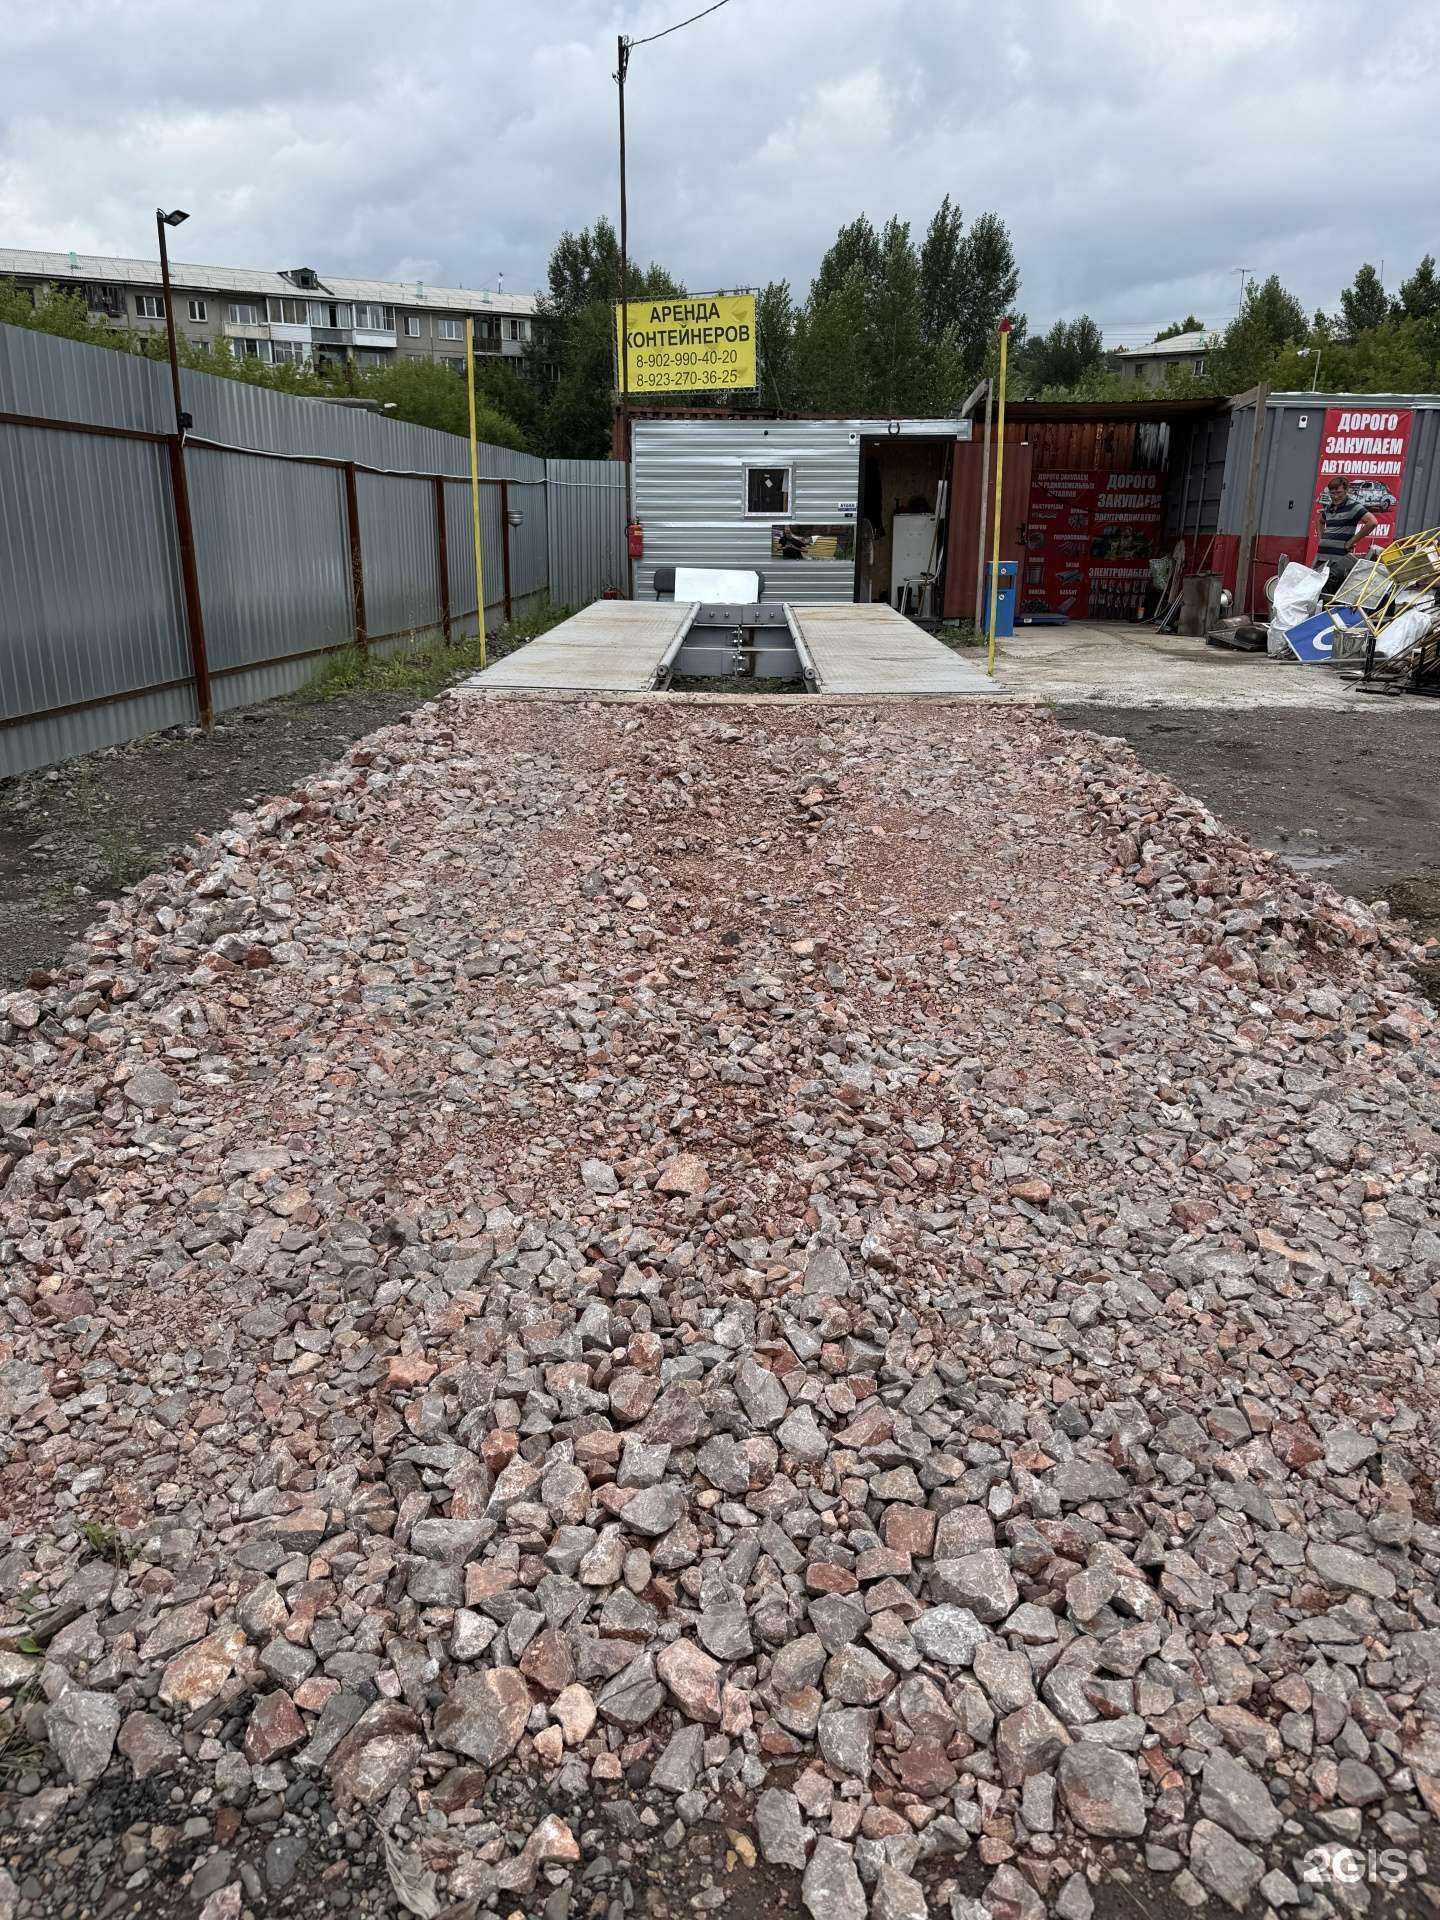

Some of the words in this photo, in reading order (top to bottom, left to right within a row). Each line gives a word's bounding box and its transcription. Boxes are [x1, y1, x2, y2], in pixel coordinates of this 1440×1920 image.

[650, 303, 720, 323] АРЕНДА
[636, 350, 738, 368] 8-902-990-40-20
[636, 370, 738, 387] 8-923-270-36-25
[1337, 413, 1399, 432] ДОРОГО
[1325, 437, 1404, 455] ЗАКУПАЕМ
[1321, 460, 1401, 474] АВТОМОБИЛИ
[1107, 474, 1156, 490] ДОРОГО
[1097, 493, 1162, 508] ЗАКУПАЕМ
